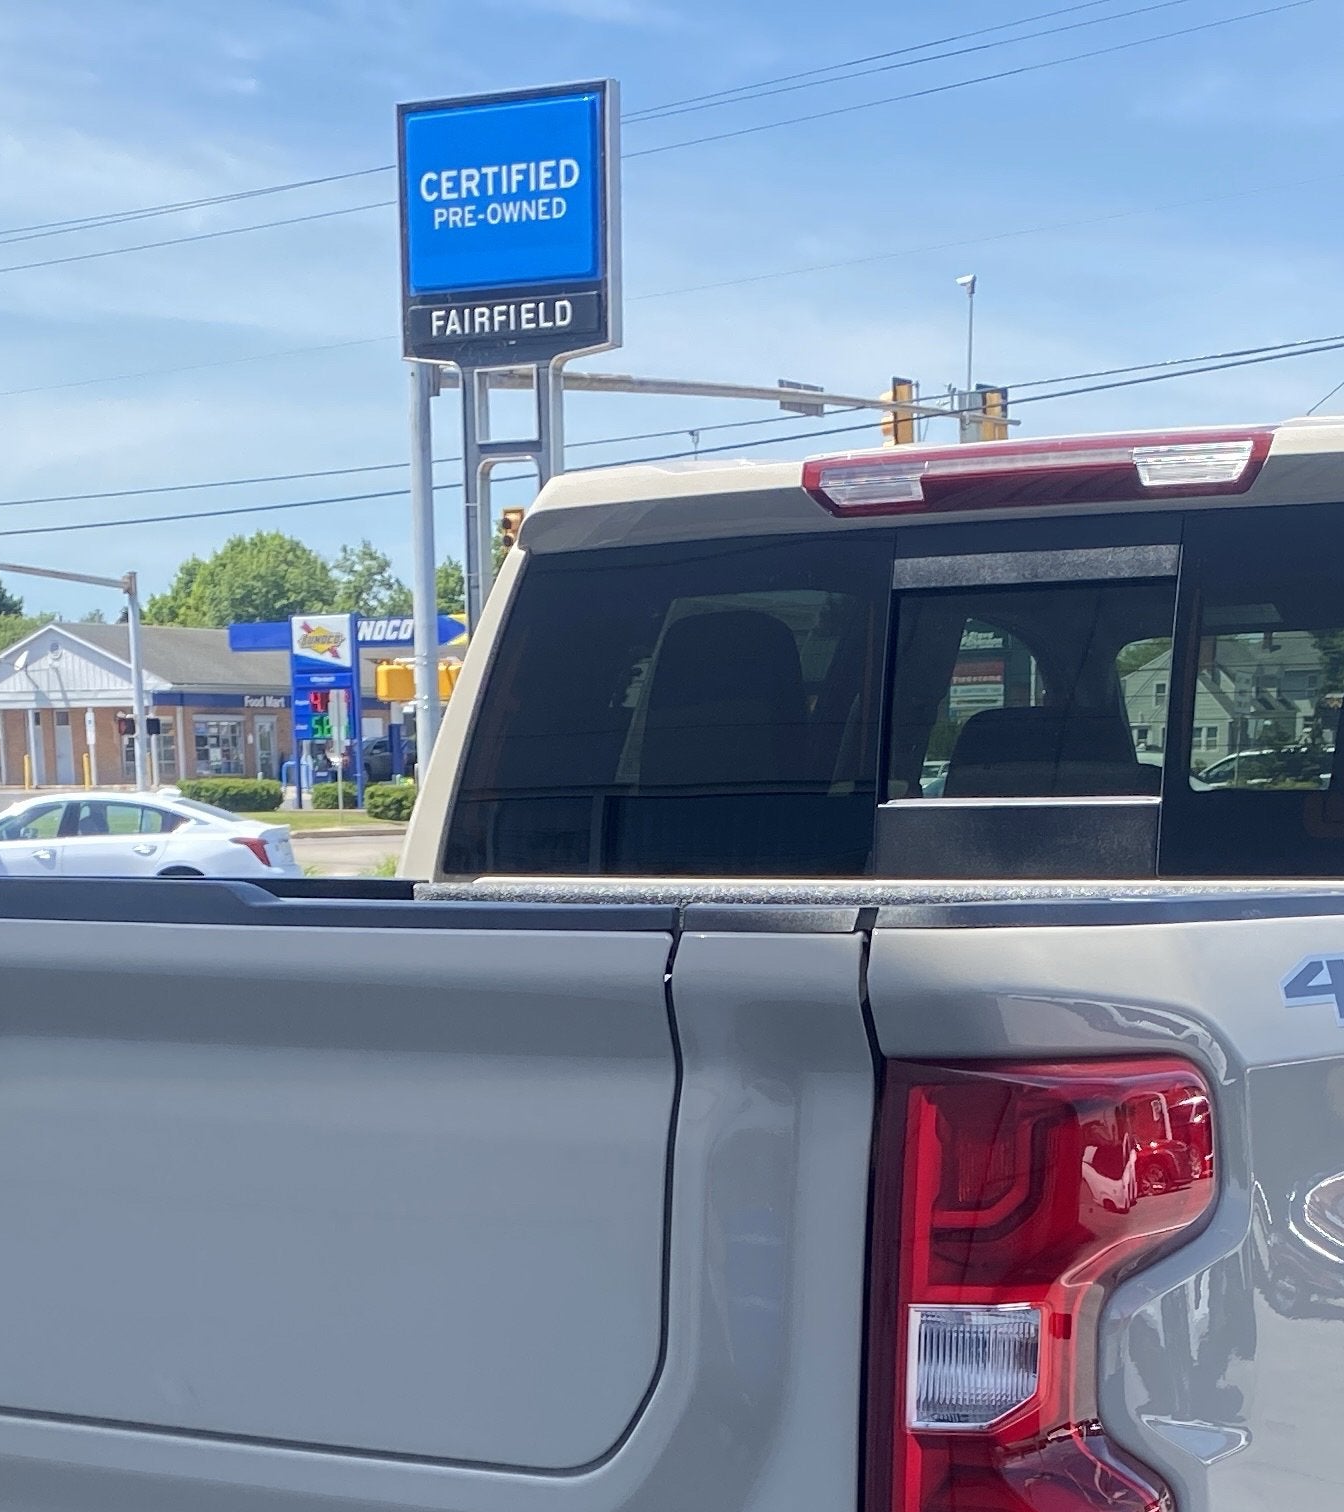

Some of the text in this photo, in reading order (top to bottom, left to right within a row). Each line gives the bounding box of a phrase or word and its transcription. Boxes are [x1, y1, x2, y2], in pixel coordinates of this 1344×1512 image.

[419, 158, 581, 202] CERTIFIED
[433, 197, 567, 230] PRE-OWNED
[431, 299, 573, 337] FAIRFIELD
[298, 632, 346, 648] SUNOCO
[356, 619, 415, 641] NOCO
[244, 695, 265, 708] Food
